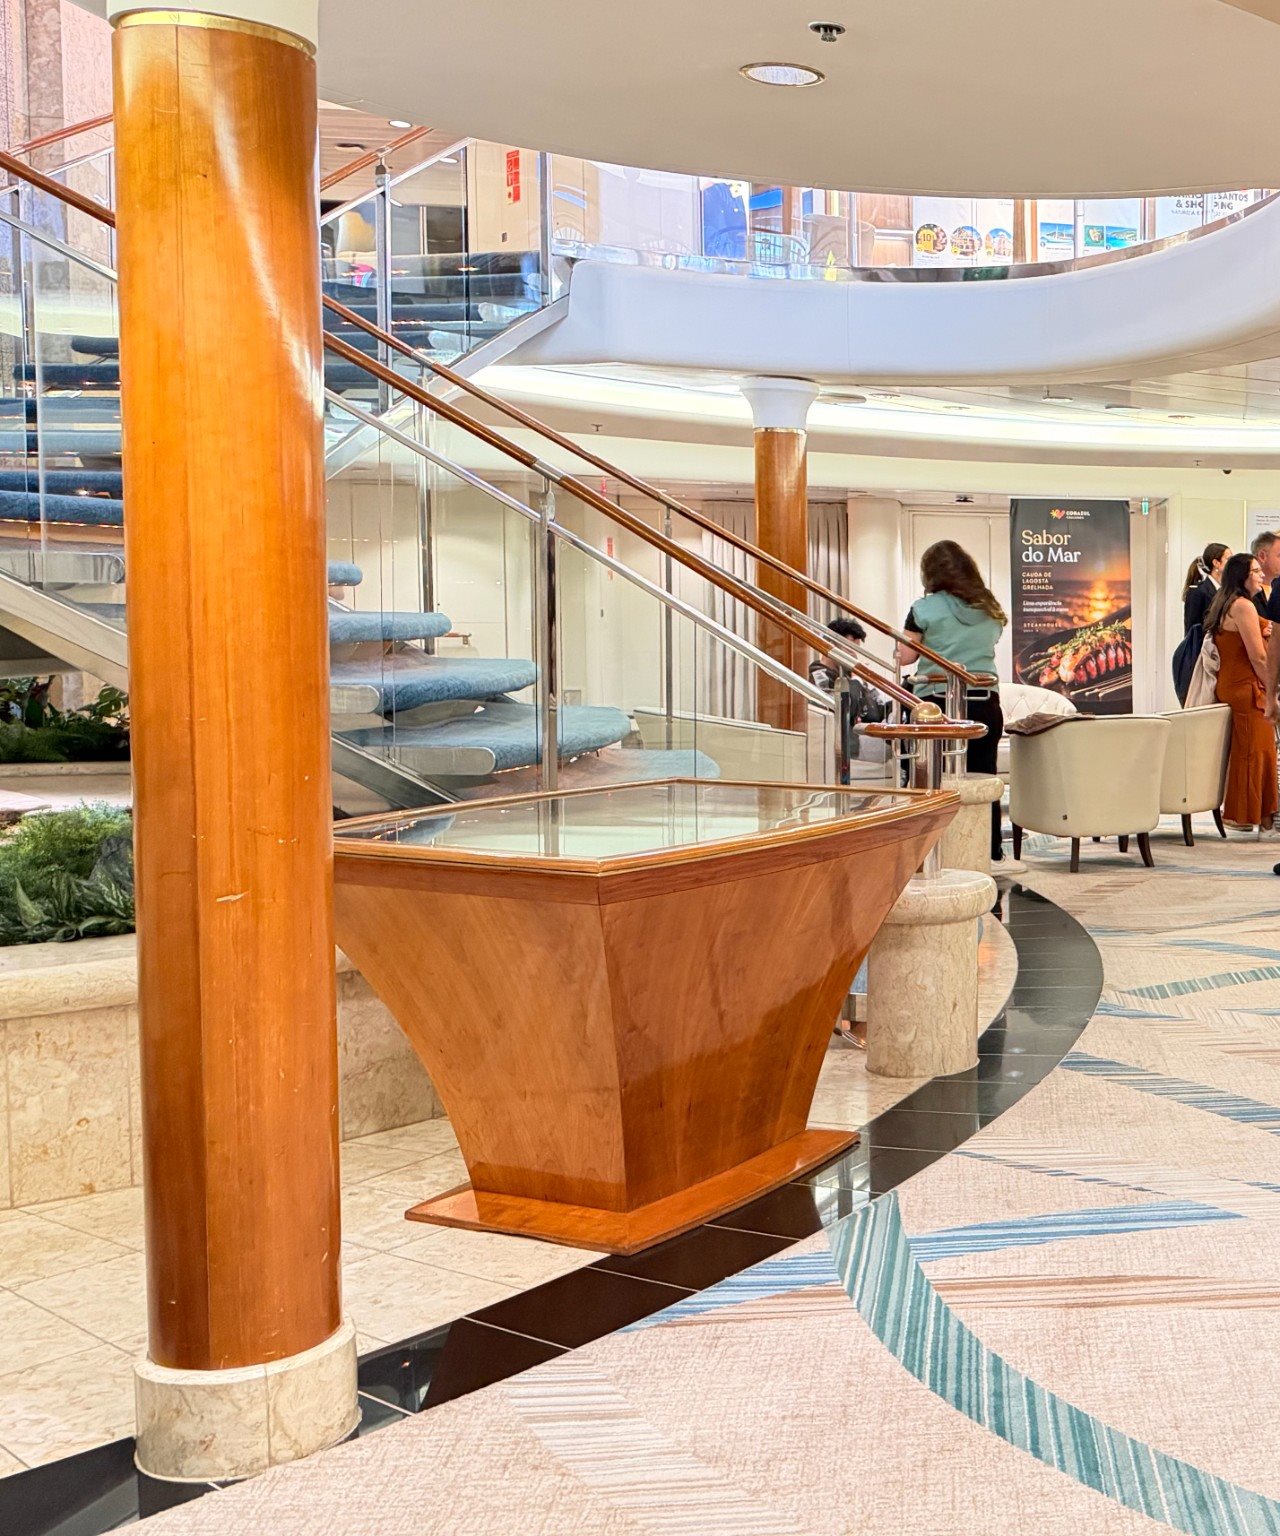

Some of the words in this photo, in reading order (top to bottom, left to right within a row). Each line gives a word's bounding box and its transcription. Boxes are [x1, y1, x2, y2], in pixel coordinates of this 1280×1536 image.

[1021, 530, 1071, 545] Sabor
[1022, 547, 1043, 562] do
[1047, 547, 1082, 562] Mar
